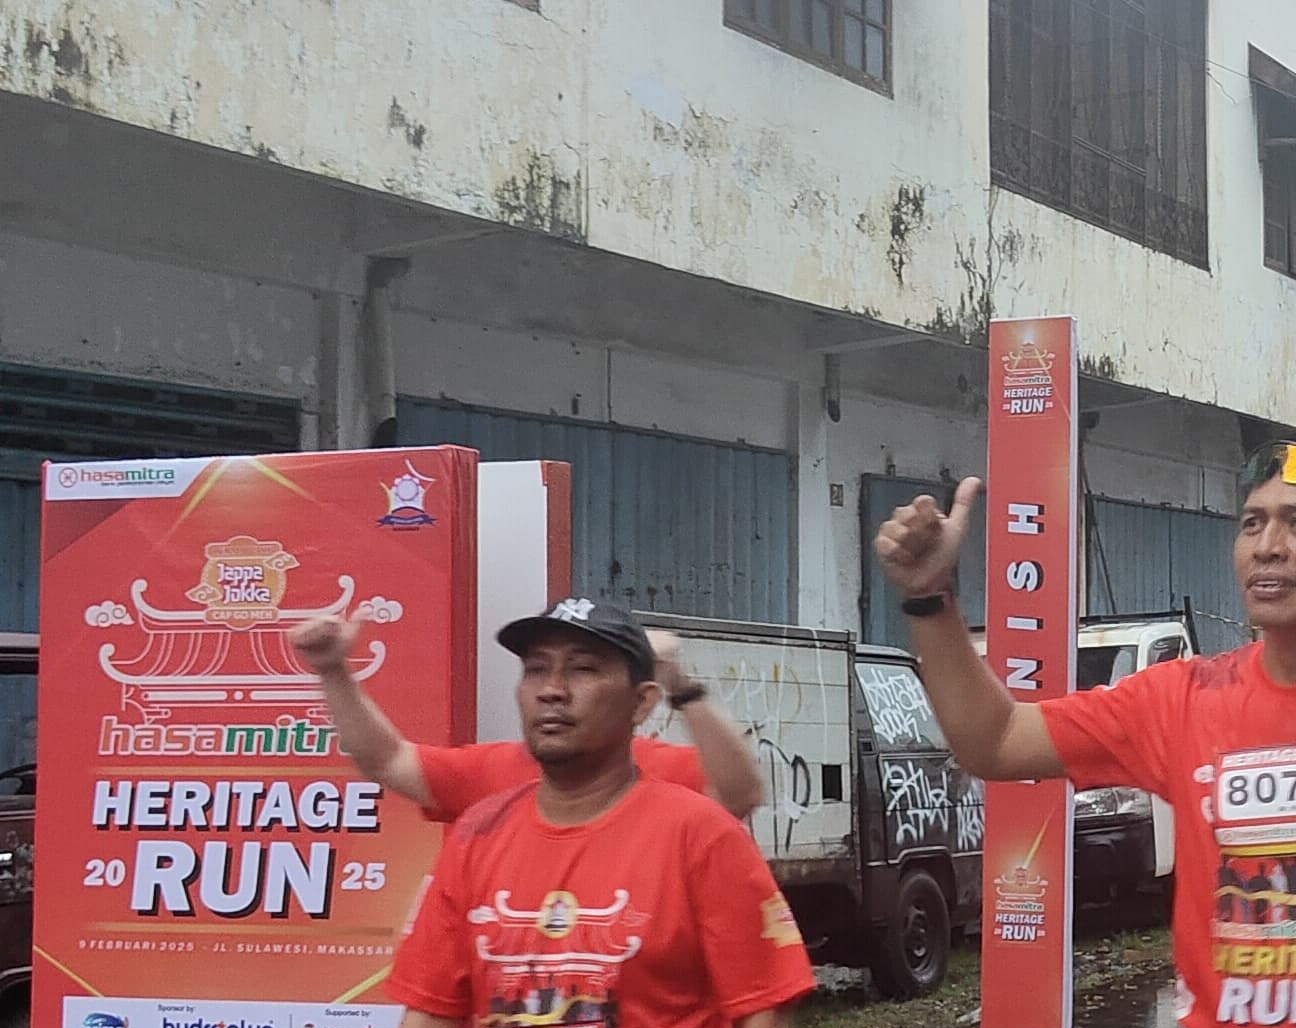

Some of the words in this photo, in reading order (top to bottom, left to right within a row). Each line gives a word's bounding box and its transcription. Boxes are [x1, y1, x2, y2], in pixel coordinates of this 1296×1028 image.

[1003, 387, 1053, 398] HERITAGE
[1010, 399, 1044, 413] RUN
[81, 467, 175, 482] hasamitra
[217, 563, 264, 586] Jappa
[1006, 503, 1038, 784] NISH
[99, 715, 351, 757] hasamitr
[92, 780, 382, 830] HERITAGE
[83, 859, 126, 887] 20
[131, 840, 332, 916] RUN
[340, 862, 386, 891] 25
[995, 913, 1045, 925] HERITAGE
[1001, 925, 1036, 941] RUN
[89, 940, 156, 951] FEBRUARI
[159, 941, 194, 952] 2025
[317, 944, 394, 956] MAKASSAR
